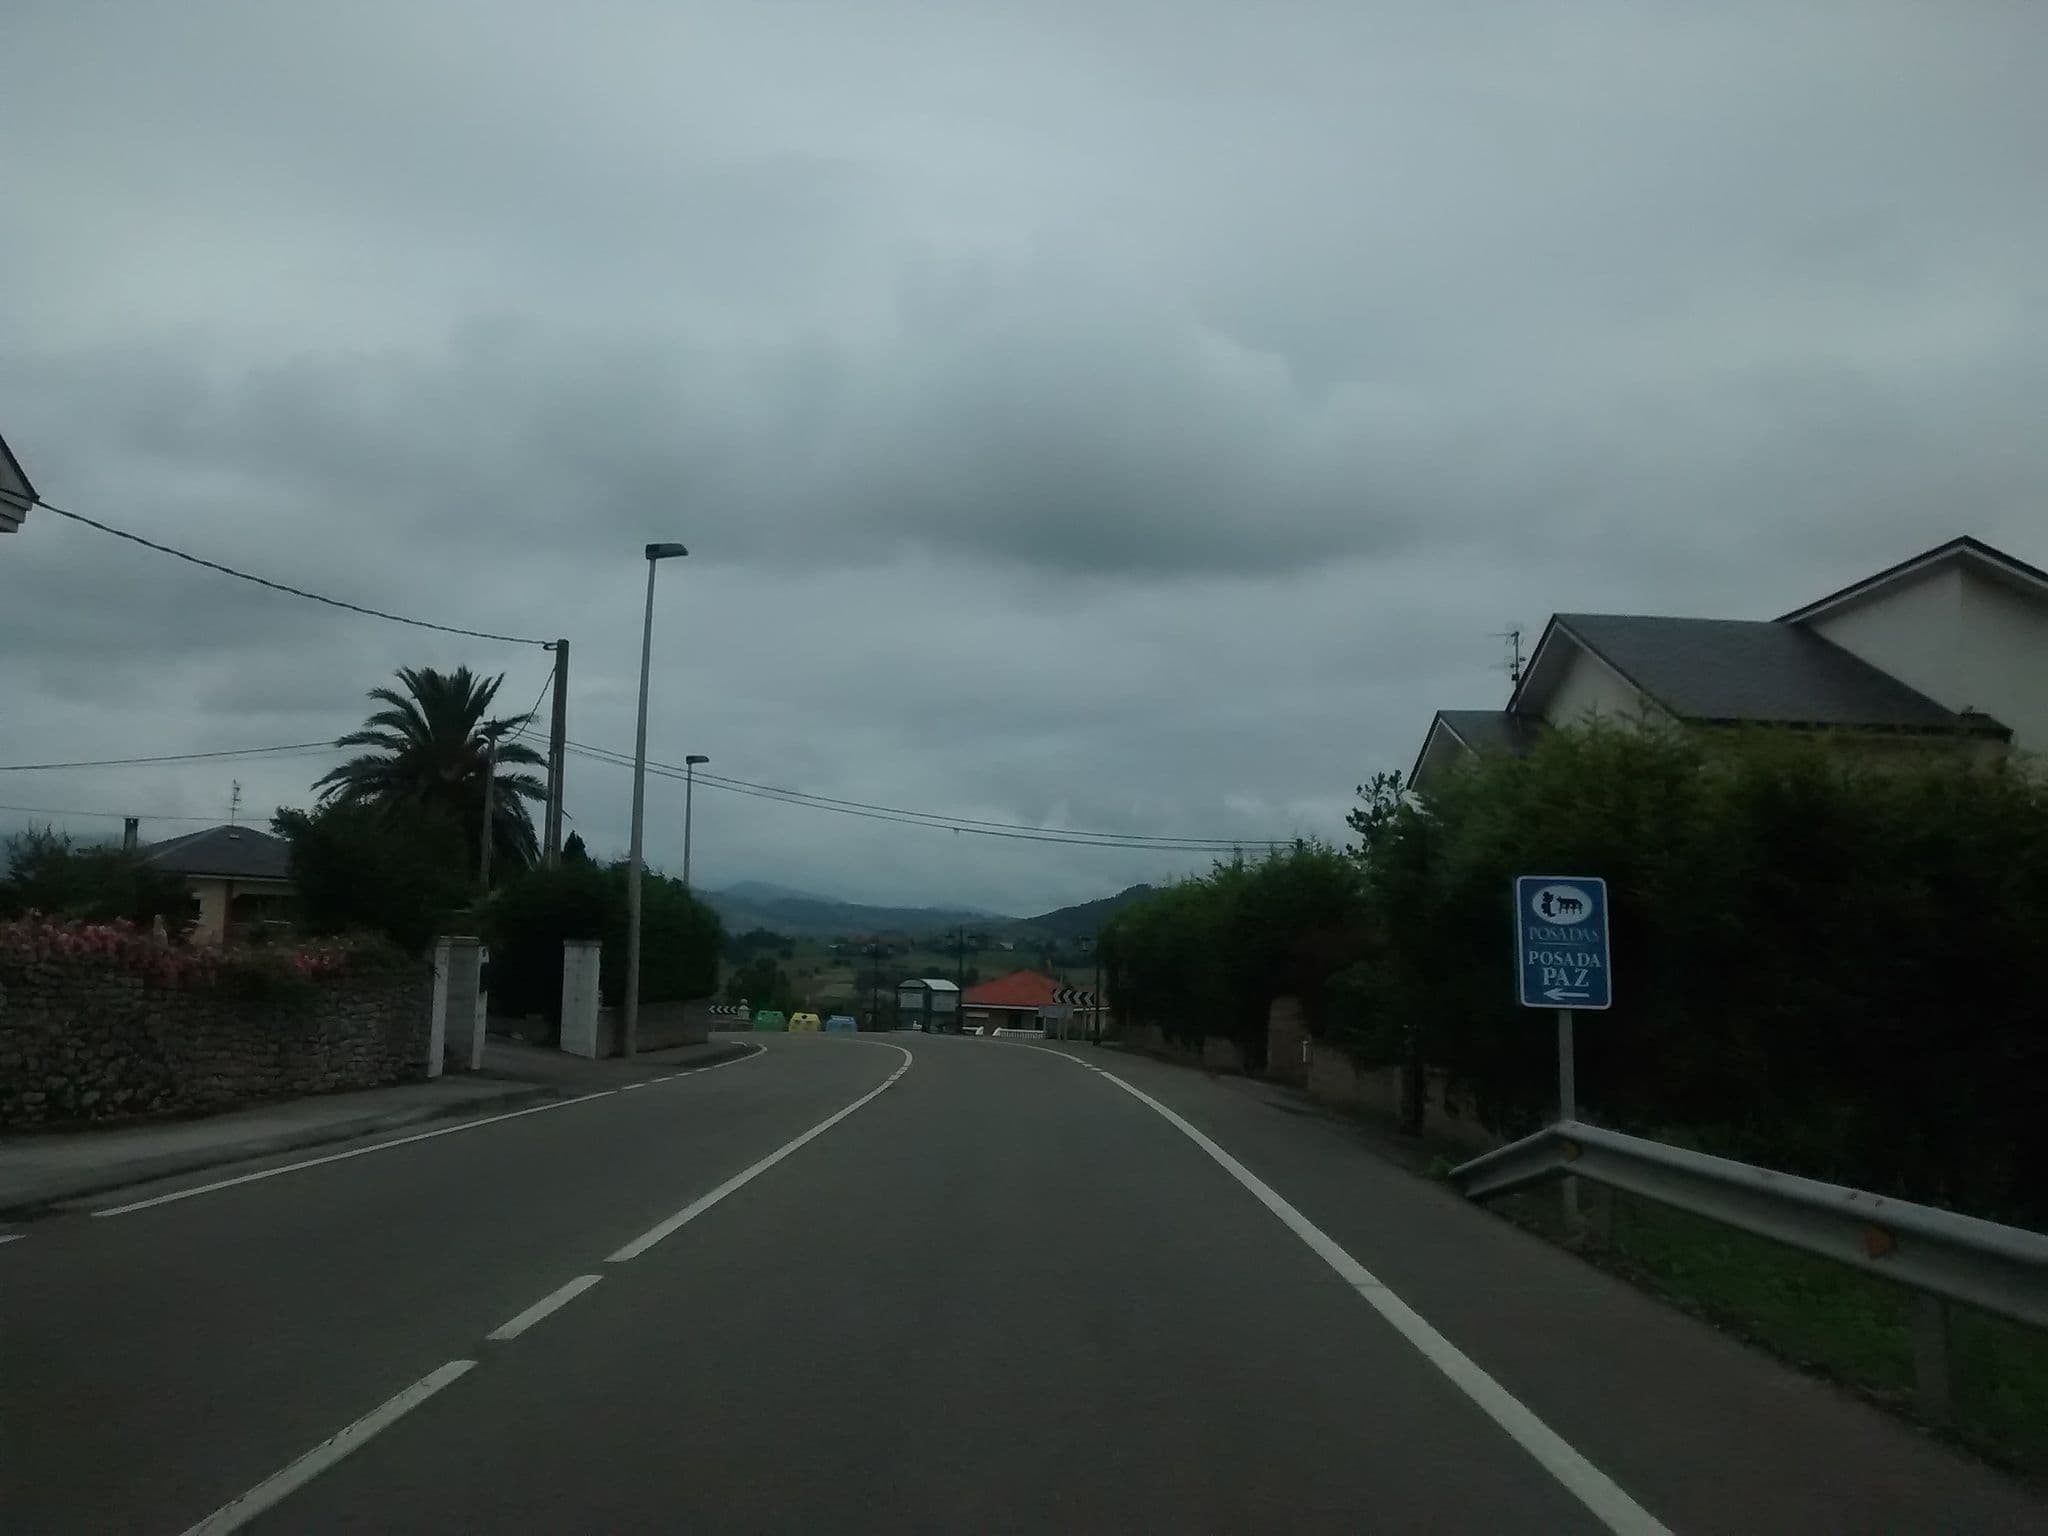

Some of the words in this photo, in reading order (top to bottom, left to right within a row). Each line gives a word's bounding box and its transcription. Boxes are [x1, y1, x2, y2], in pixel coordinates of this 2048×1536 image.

[1529, 927, 1600, 942] POSADAS
[1528, 951, 1601, 968] POSADA
[1543, 967, 1589, 987] PAZ
